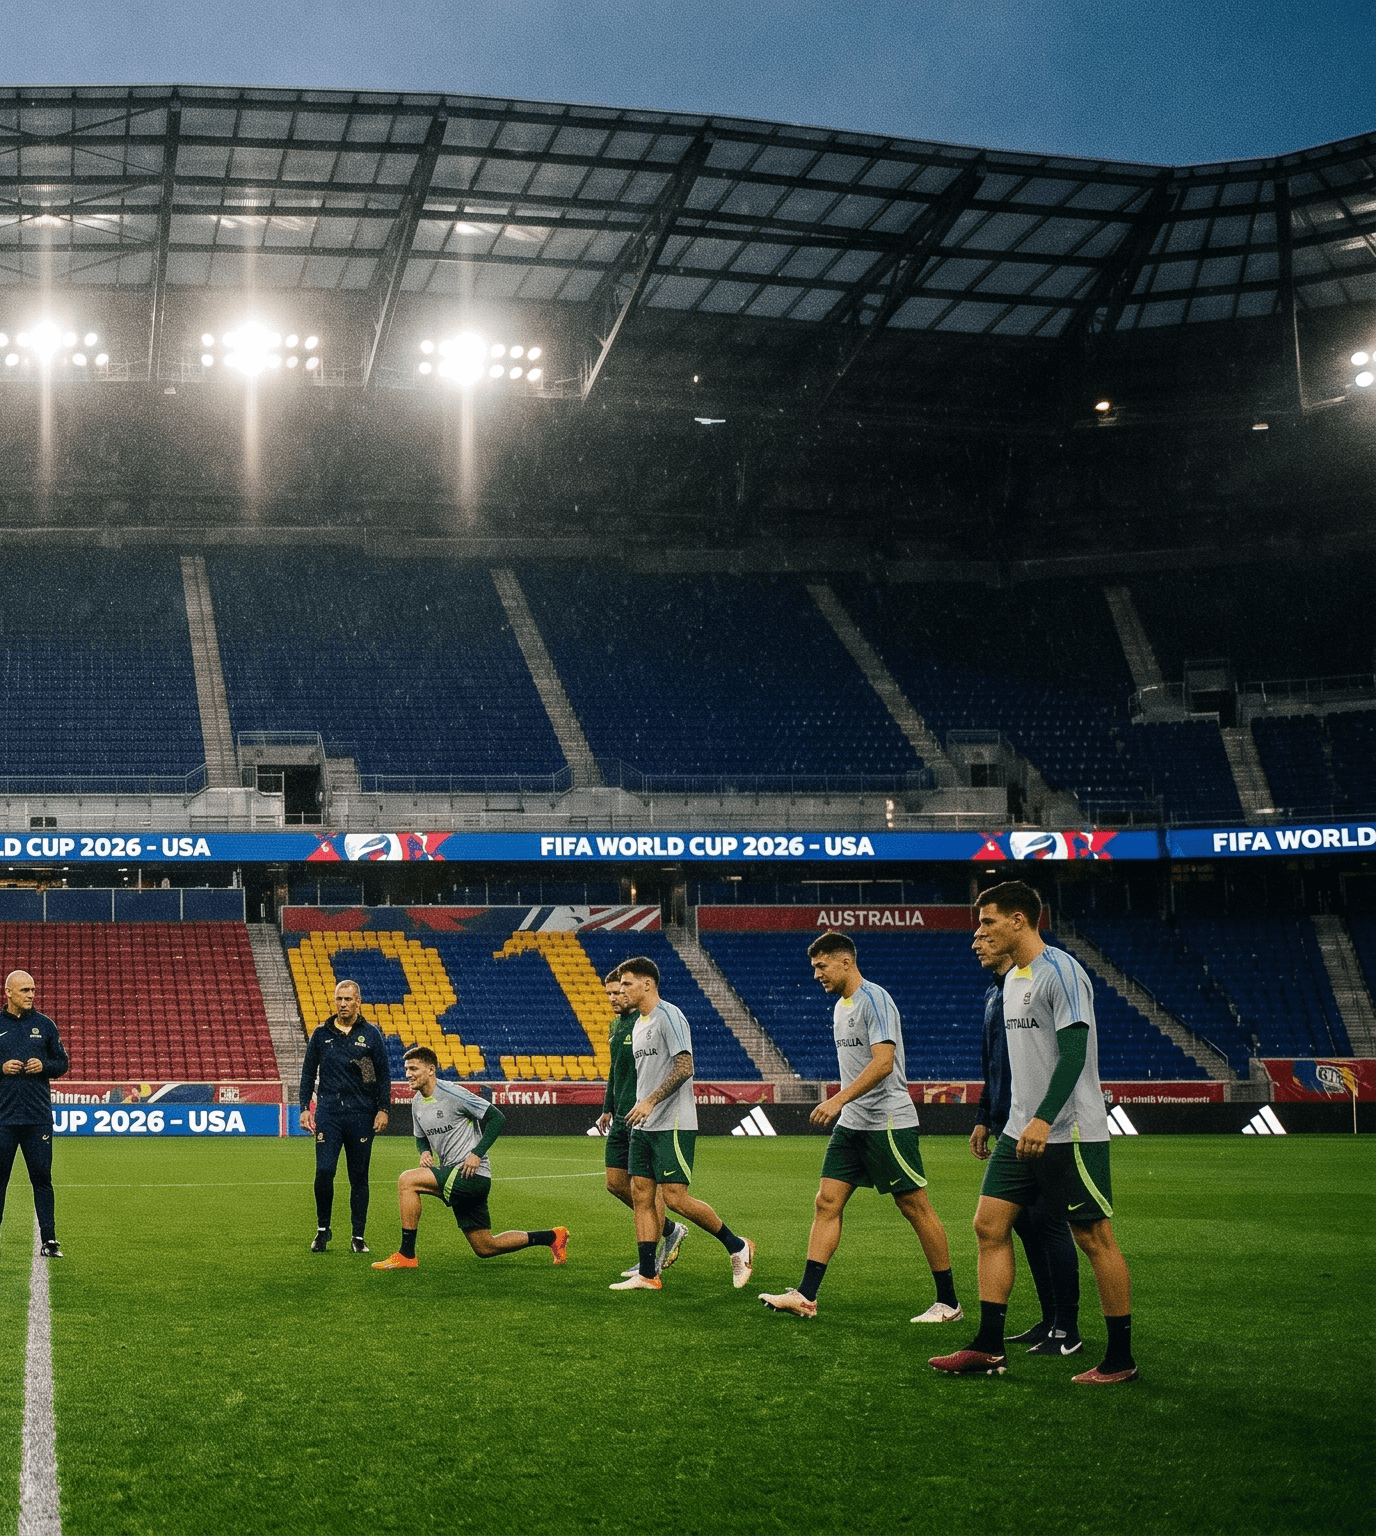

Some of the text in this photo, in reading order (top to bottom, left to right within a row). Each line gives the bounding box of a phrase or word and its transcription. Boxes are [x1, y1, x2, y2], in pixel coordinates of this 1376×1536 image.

[27, 838, 75, 857] CUP
[81, 838, 142, 857] 2026
[163, 838, 212, 857] USA
[541, 837, 594, 856] FIFA
[596, 837, 685, 856] WORLD
[690, 837, 738, 856] CUP
[743, 837, 805, 856] 2026
[825, 837, 875, 856] USA
[1213, 827, 1376, 852] FIFA WORLD
[817, 910, 924, 927] AUSTRALIA
[52, 1110, 88, 1132] UP
[94, 1110, 165, 1133] 2026
[189, 1110, 246, 1133] USA
